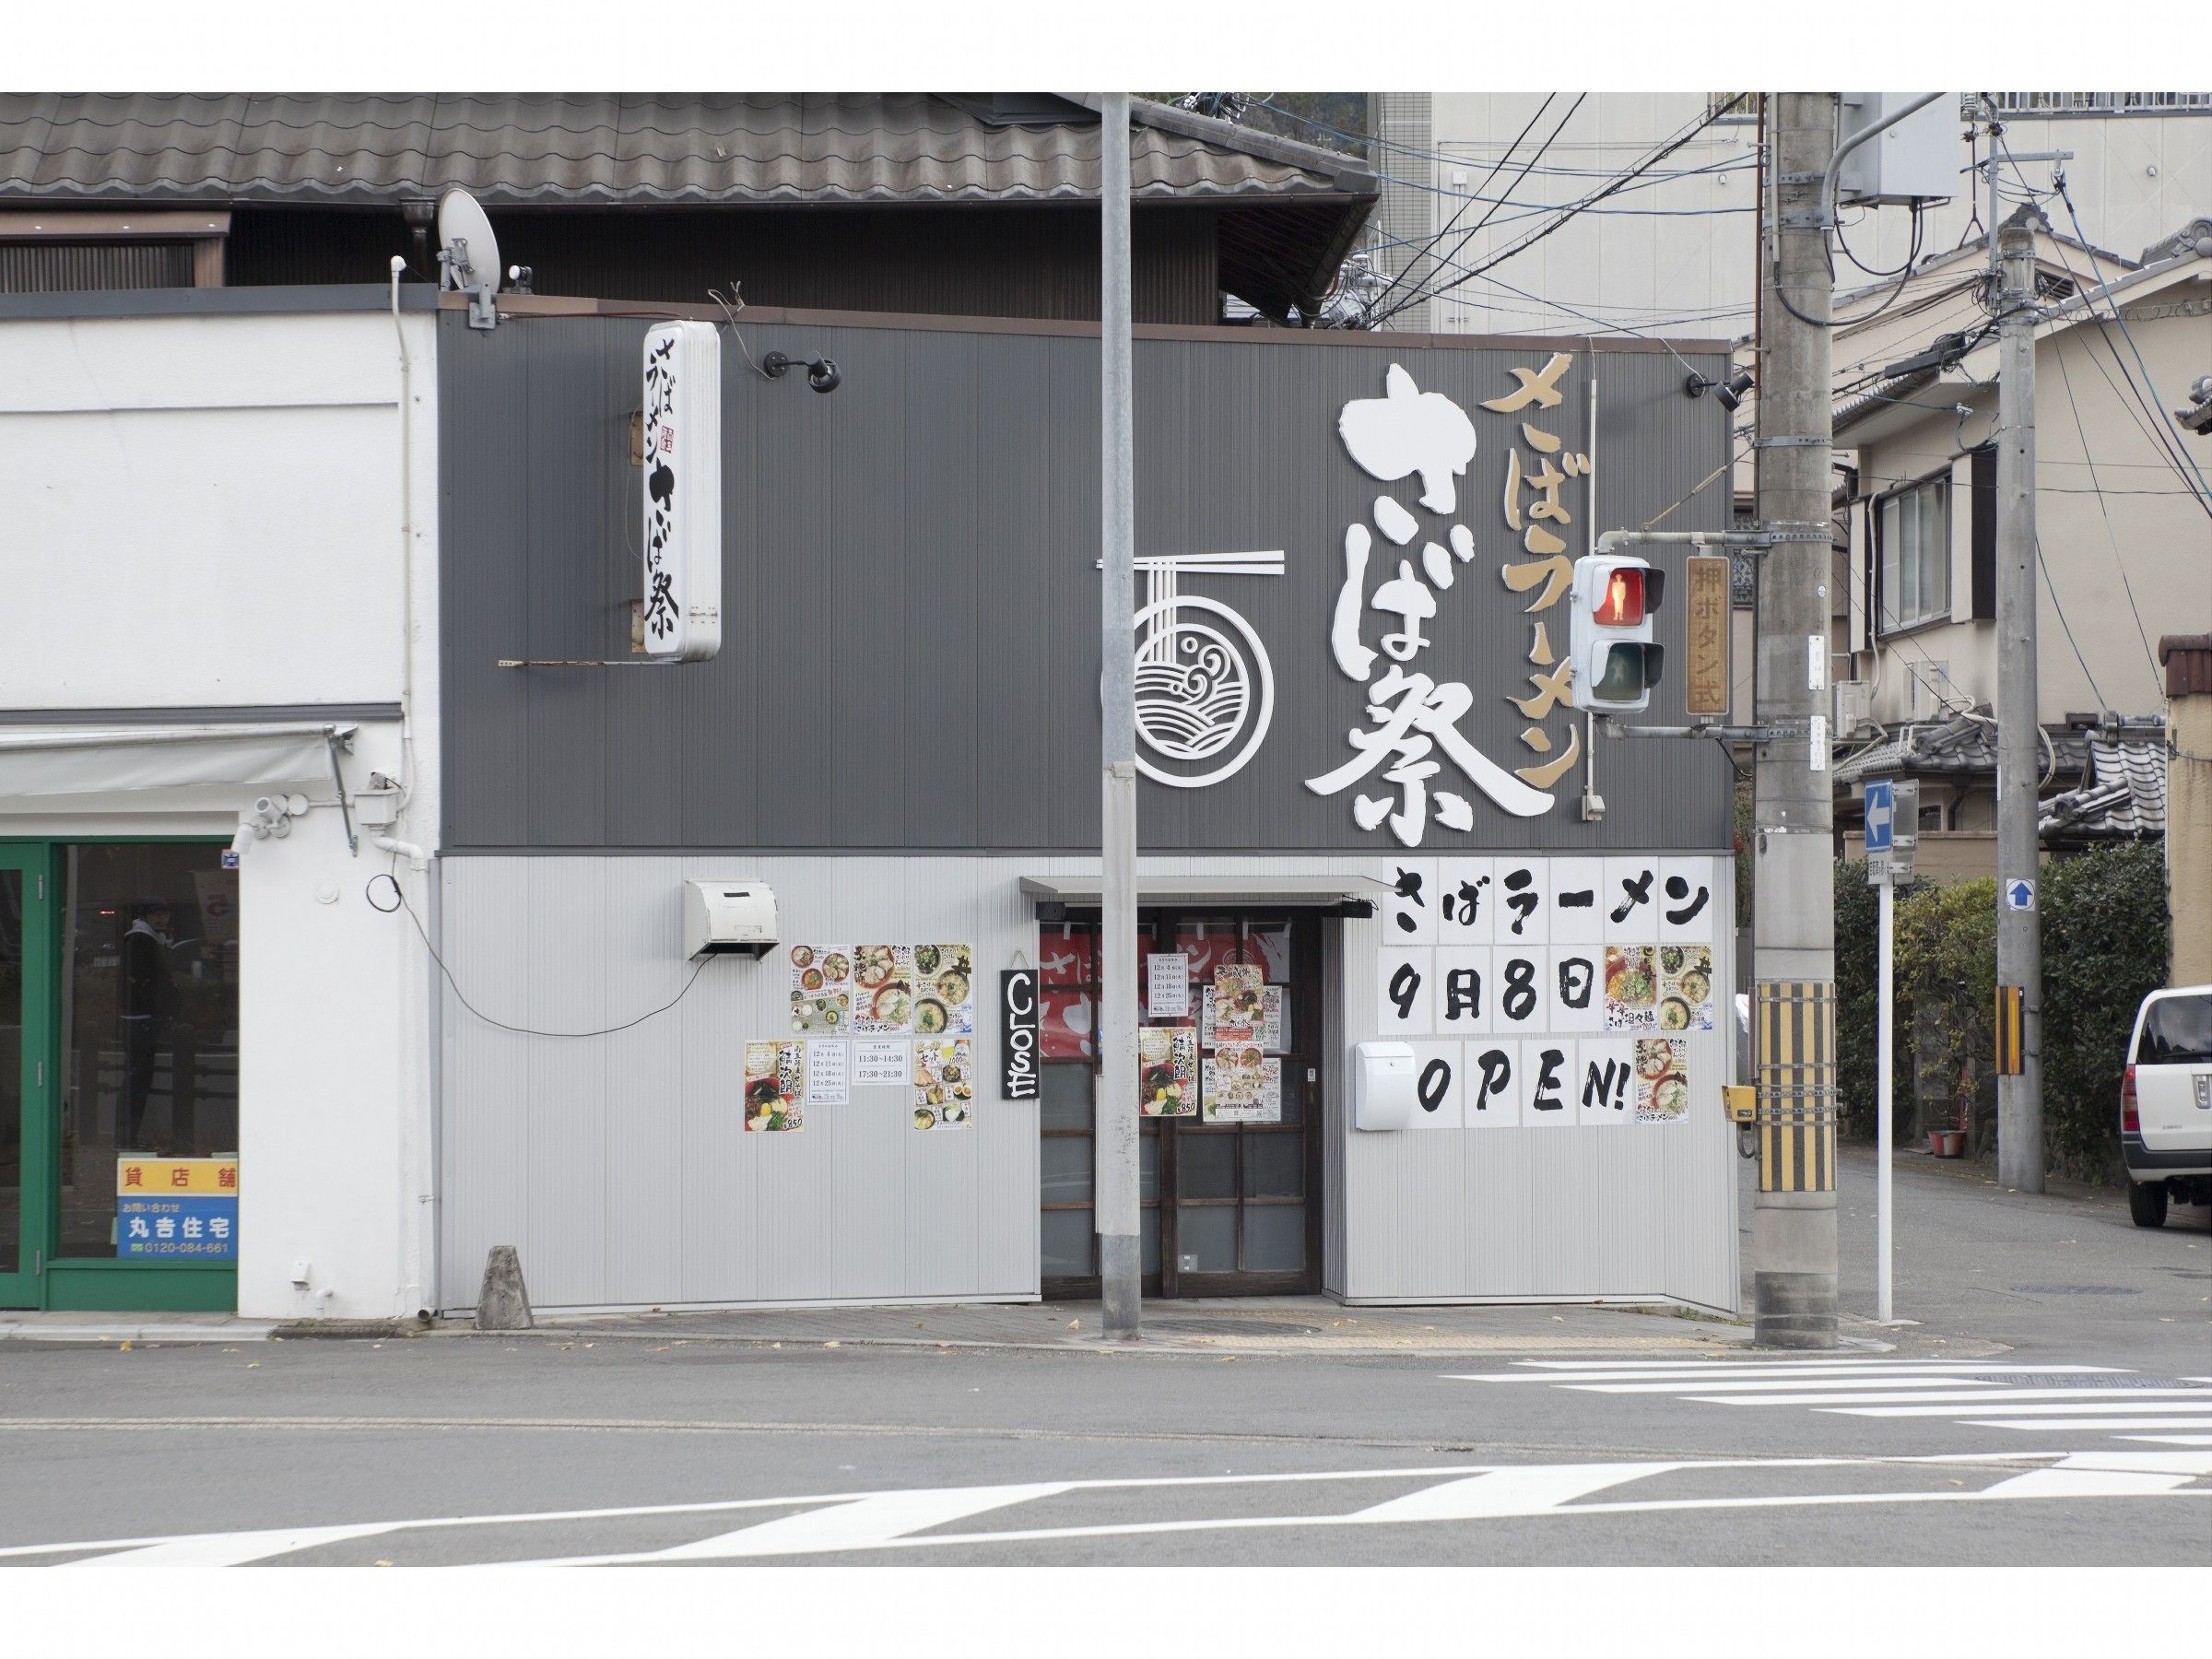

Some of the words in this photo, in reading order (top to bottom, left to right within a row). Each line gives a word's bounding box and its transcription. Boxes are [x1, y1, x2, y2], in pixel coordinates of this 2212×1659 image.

[1304, 362, 1555, 848] さば祭
[1695, 566, 1722, 706] 押ボタン式
[1395, 865, 1710, 935] さばラーメン
[1389, 957, 1594, 1021] 9月8日
[921, 1052, 939, 1063] セット
[1006, 972, 1036, 1098] CLOSE
[1418, 1049, 1631, 1112] OPEN!
[122, 1202, 181, 1213] お問い合わせ
[124, 1167, 236, 1188] 貸店舗
